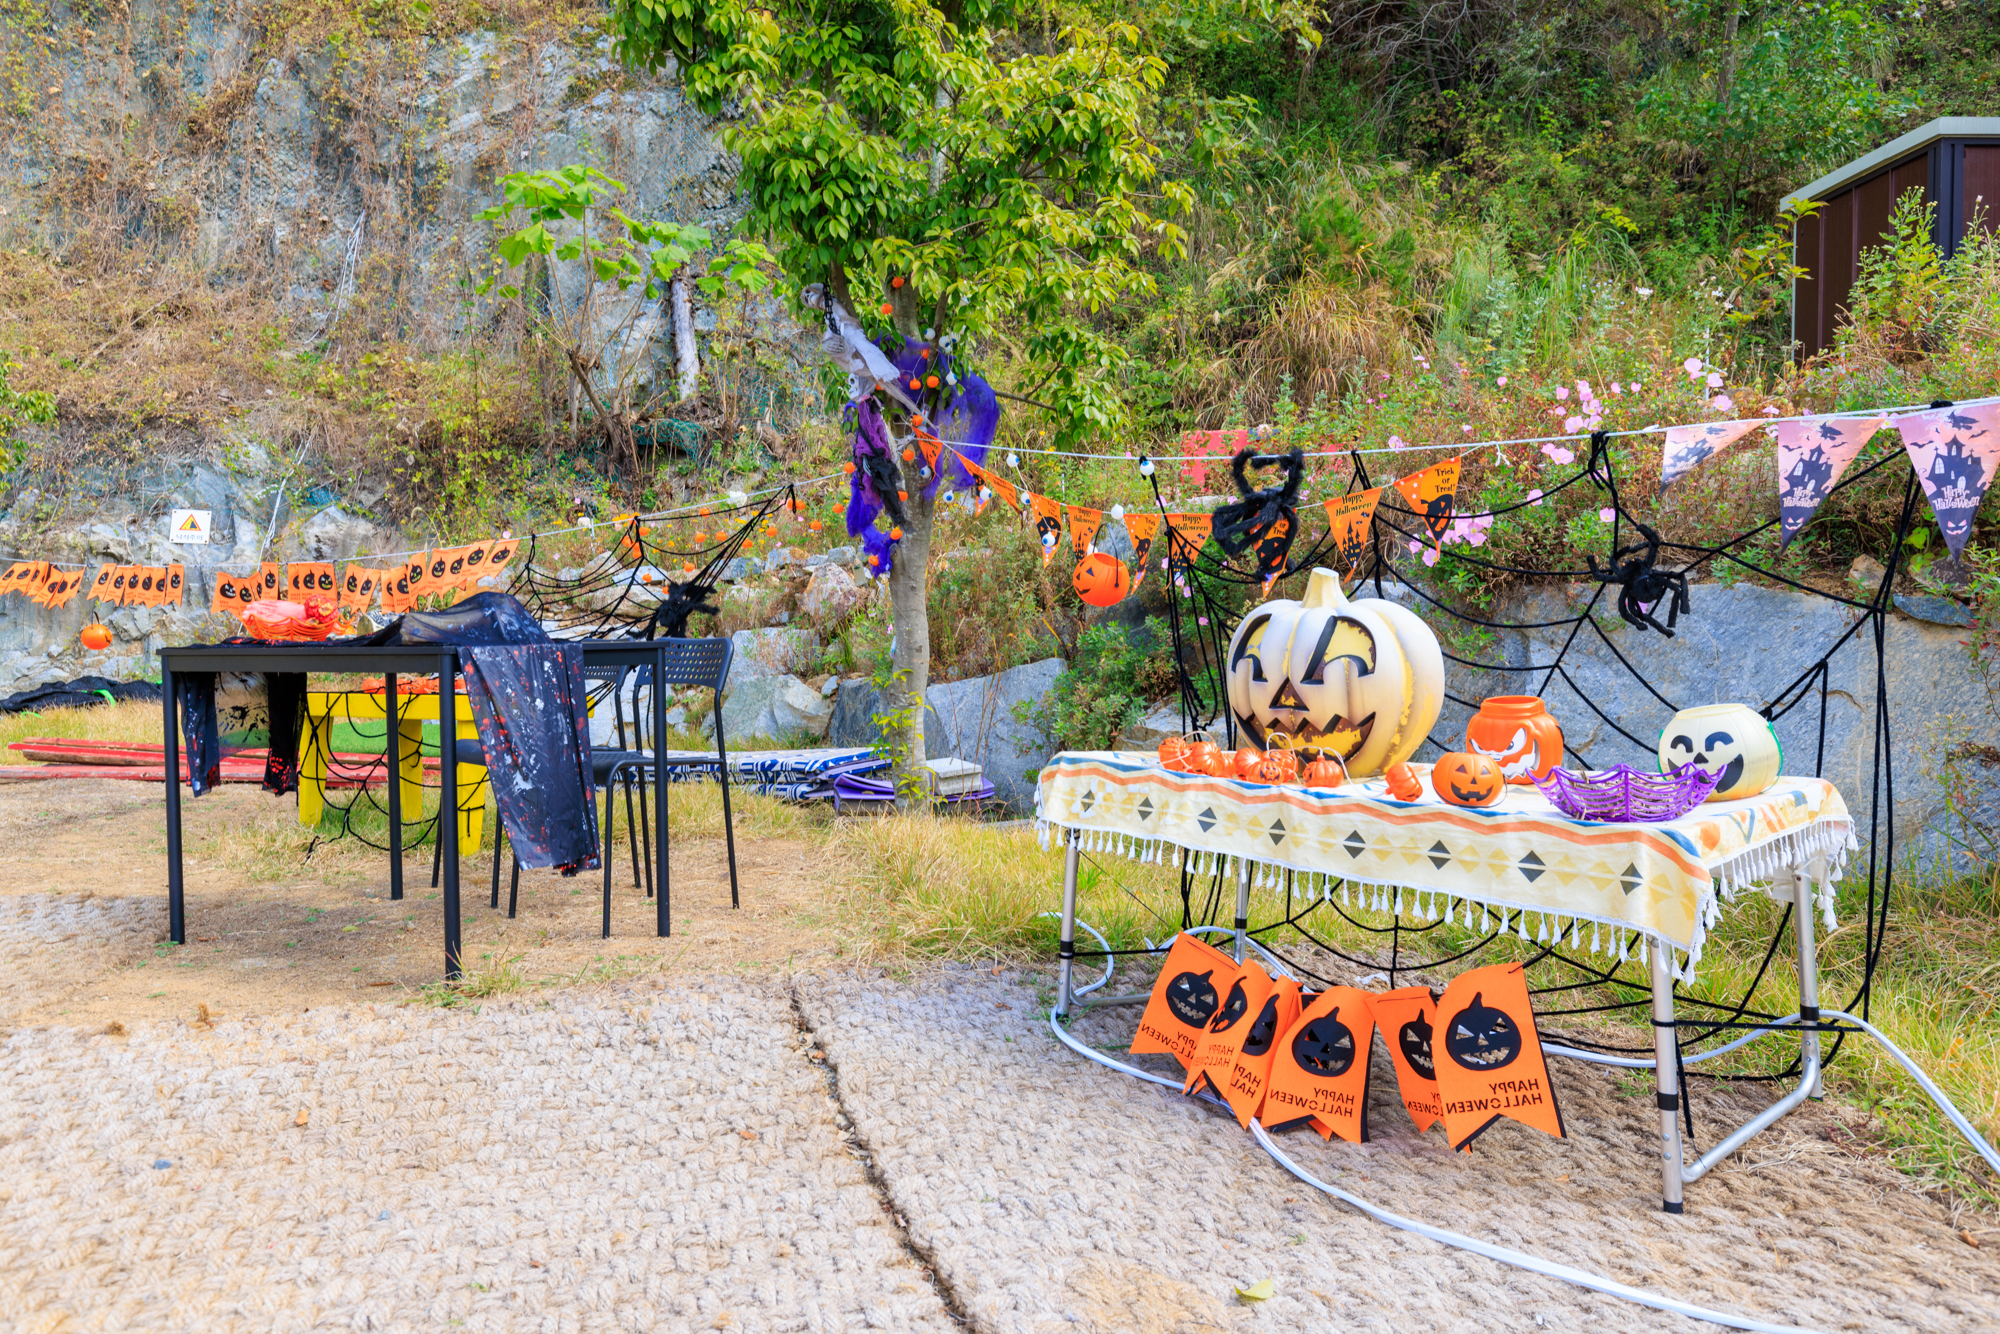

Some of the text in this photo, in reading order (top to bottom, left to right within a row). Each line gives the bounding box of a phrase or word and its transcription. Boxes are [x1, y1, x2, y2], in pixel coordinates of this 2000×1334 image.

[1435, 467, 1454, 476] Trick
[1941, 485, 1970, 499] Happy
[1342, 493, 1365, 505] Happy
[1336, 502, 1372, 517] Halloween
[1182, 514, 1202, 525] Happy
[1175, 523, 1209, 531] Halloween
[1273, 527, 1285, 536] Trea
